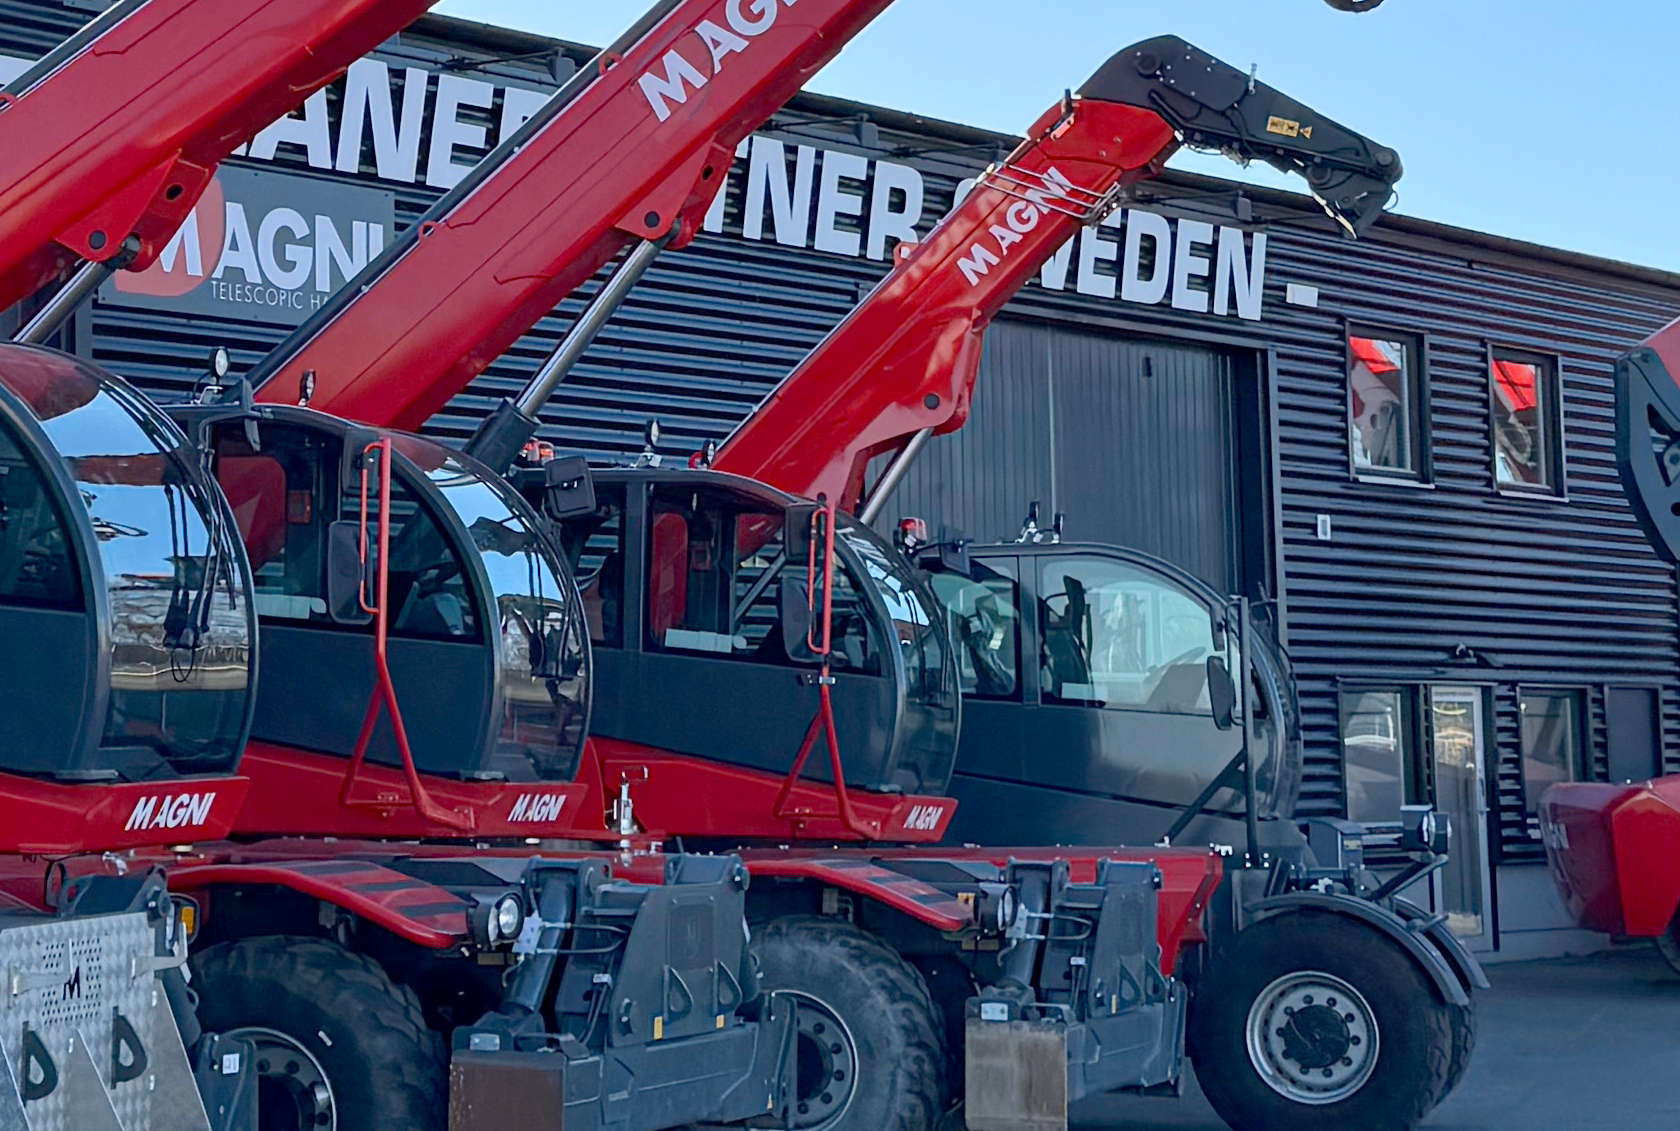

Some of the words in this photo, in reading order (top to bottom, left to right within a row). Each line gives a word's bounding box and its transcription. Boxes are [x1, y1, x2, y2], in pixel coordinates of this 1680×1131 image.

[956, 166, 1073, 287] MAGNI
[211, 280, 304, 310] TELESCOPIC
[124, 792, 217, 832] MAGNI
